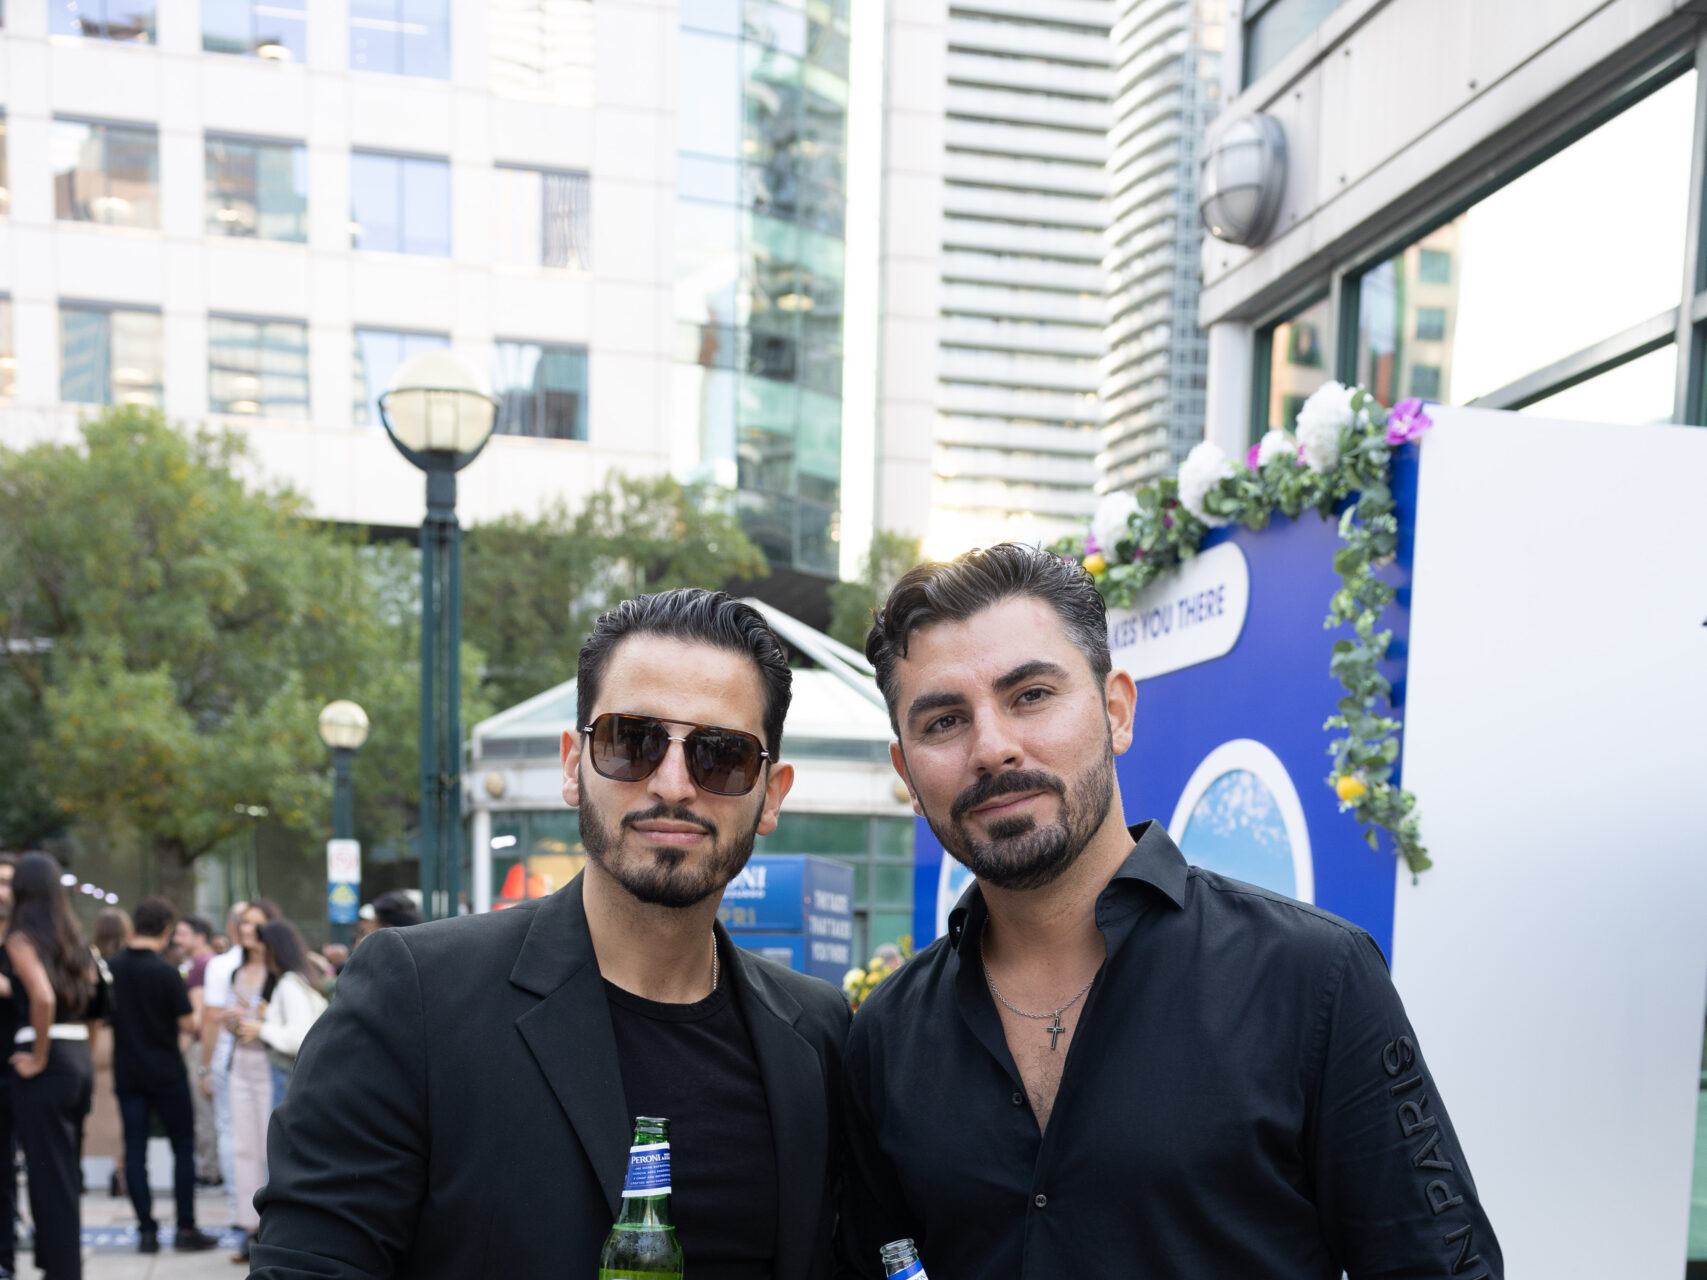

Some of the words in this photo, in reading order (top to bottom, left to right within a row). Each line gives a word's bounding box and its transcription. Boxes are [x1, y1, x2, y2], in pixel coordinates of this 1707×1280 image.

[1107, 616, 1137, 650] KES
[1141, 602, 1173, 641] YOU
[1179, 584, 1224, 630] THERE
[1381, 1035, 1464, 1216] PARIS
[631, 1153, 661, 1165] PERONI
